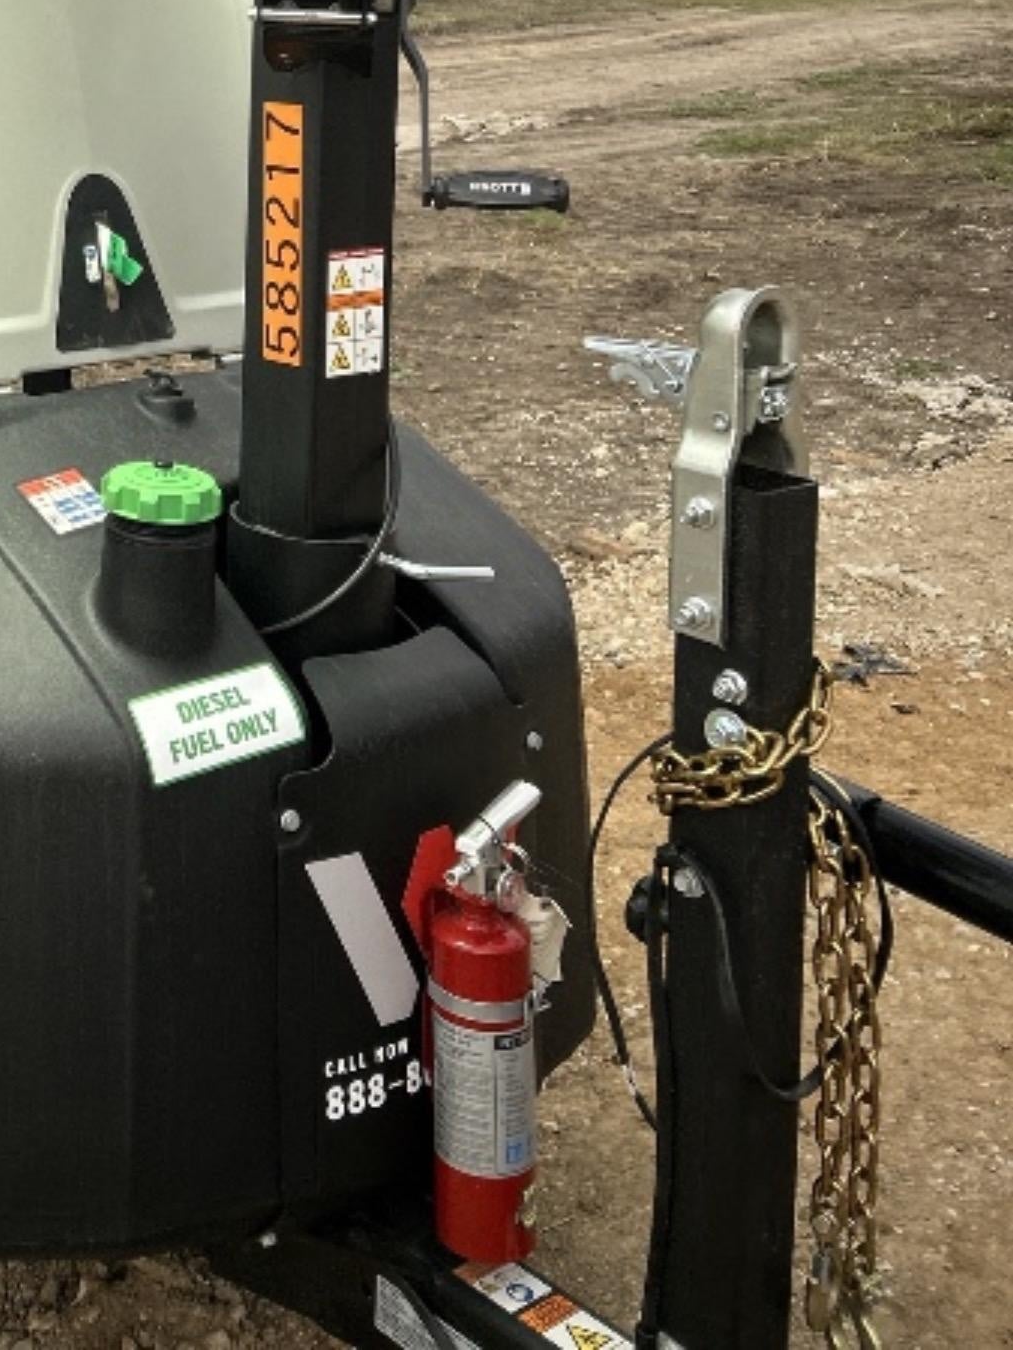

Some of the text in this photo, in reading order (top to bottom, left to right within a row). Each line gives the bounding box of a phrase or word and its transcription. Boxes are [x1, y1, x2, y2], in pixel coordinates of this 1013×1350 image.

[265, 110, 300, 358] 585217
[175, 686, 251, 724] DIESEL
[169, 707, 279, 764] FUEL ONLY
[325, 1052, 367, 1079] CALL
[325, 1058, 432, 1121] 888-8
